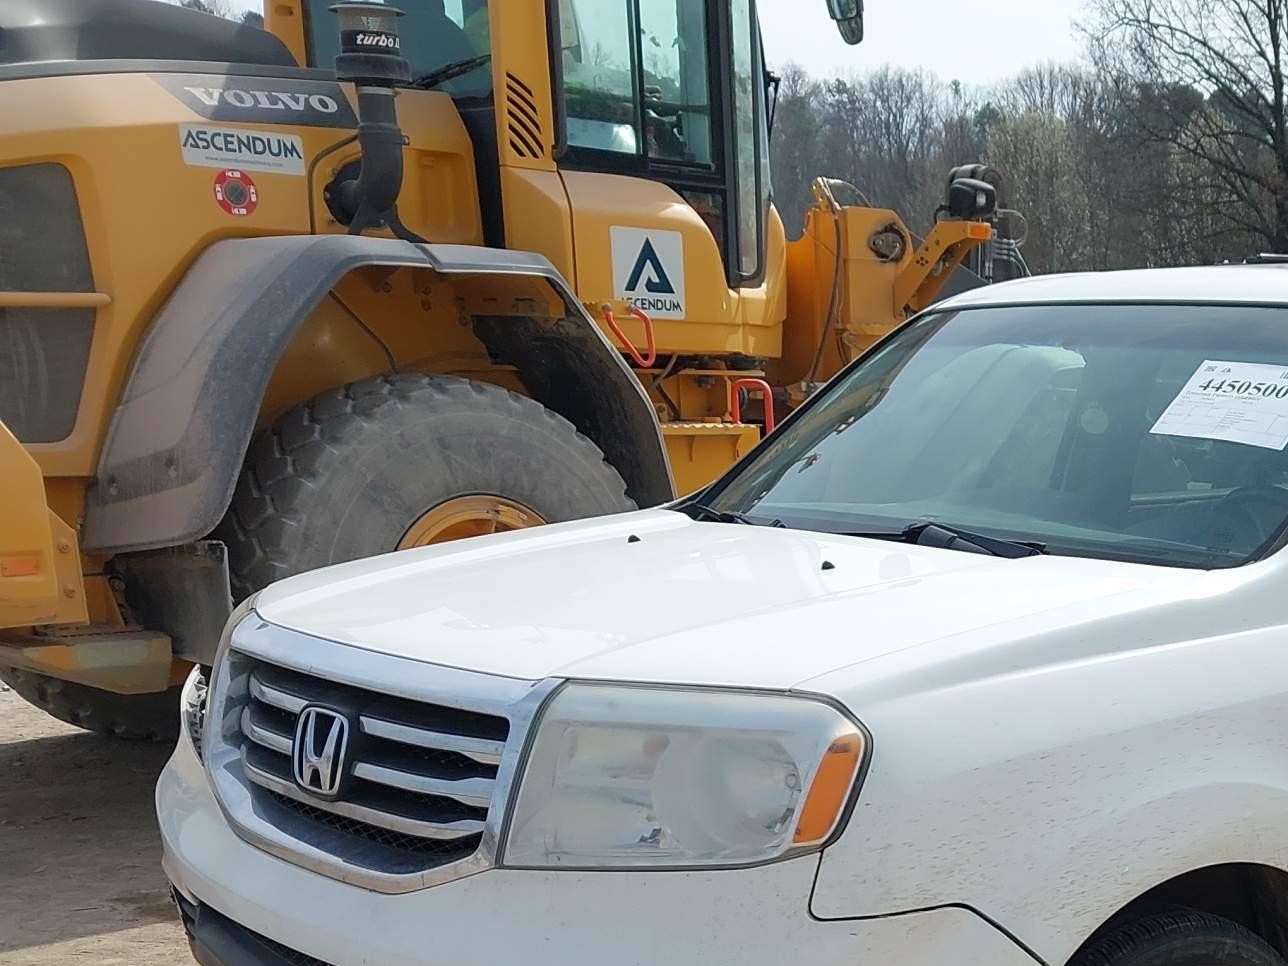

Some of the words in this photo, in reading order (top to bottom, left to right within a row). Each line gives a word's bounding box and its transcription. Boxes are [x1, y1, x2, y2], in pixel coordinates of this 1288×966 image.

[356, 33, 394, 48] turbo
[183, 87, 338, 113] VOLVO
[182, 128, 303, 160] ASCENDUM
[622, 297, 682, 312] CENDUM
